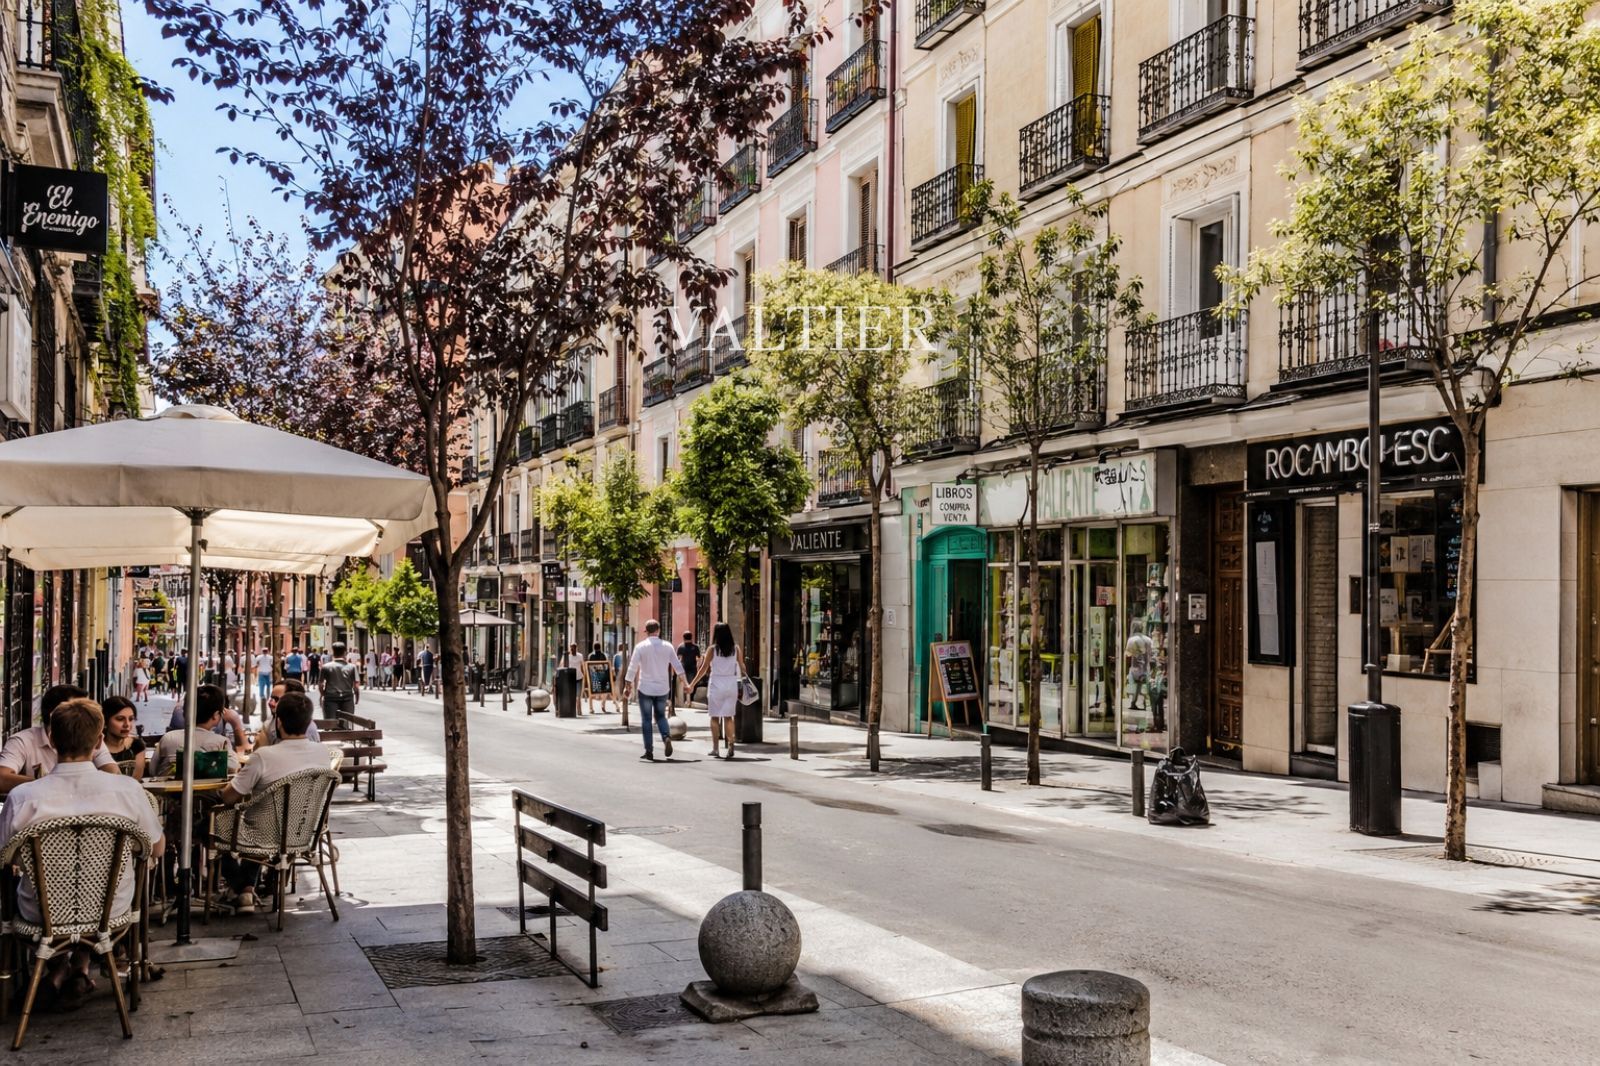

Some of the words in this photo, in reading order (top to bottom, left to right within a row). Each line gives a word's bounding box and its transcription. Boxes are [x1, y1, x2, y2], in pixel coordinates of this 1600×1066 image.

[47, 185, 73, 209] El
[22, 202, 99, 235] Enemigo
[936, 487, 973, 499] LIBROS
[939, 502, 970, 511] COMPRA
[943, 513, 968, 522] VENTA
